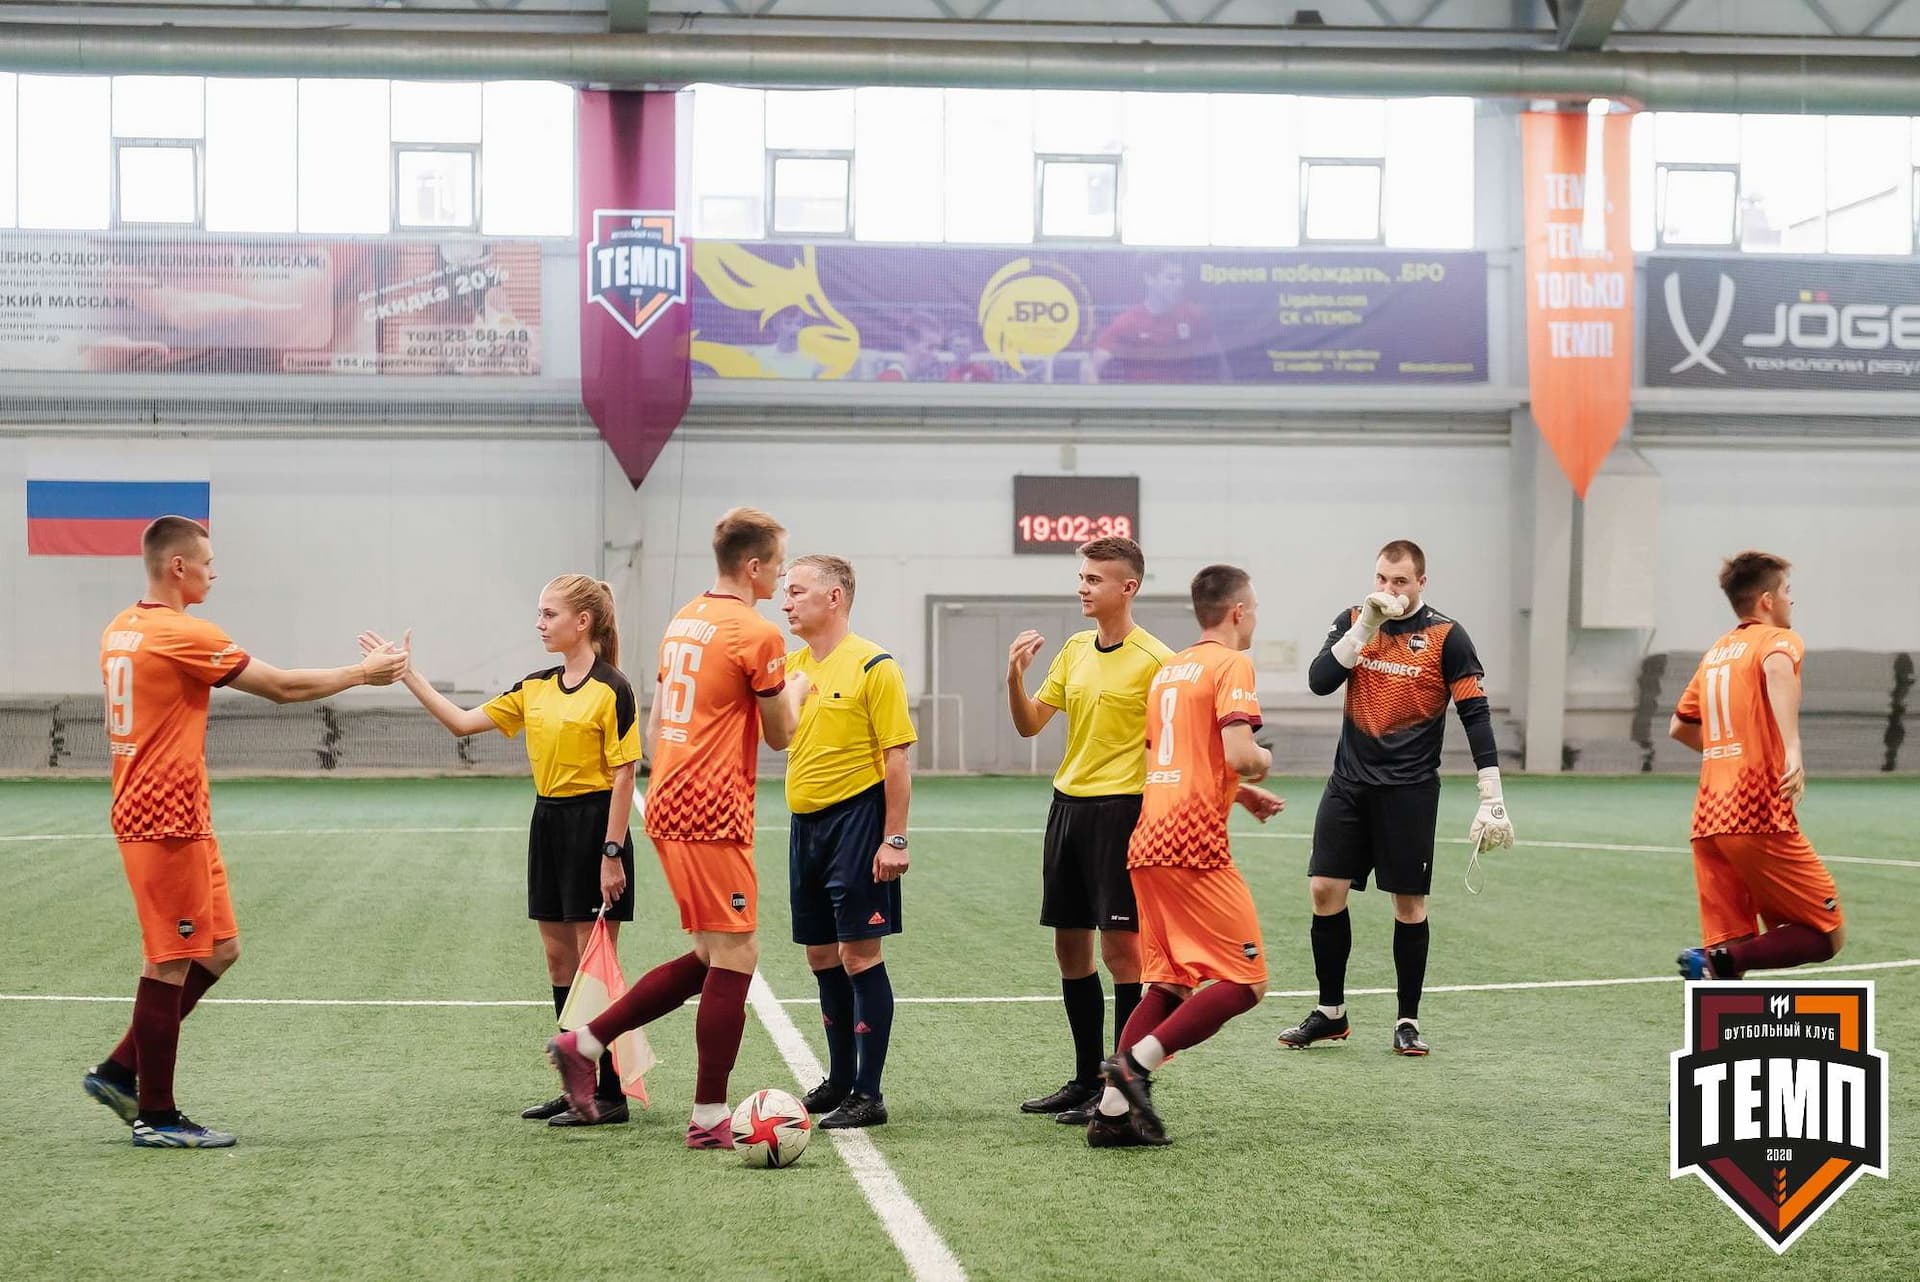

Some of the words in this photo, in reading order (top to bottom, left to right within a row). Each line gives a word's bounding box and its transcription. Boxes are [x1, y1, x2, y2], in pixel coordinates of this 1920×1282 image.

[1545, 173, 1613, 213] ТЕМ,
[1547, 222, 1614, 263] ТЕМ,
[455, 264, 509, 296] 20%
[597, 246, 676, 290] ТЕМП
[1200, 264, 1267, 284] Время
[1272, 264, 1391, 284] побеждать,
[48, 296, 134, 309] МАССАЖ:
[1536, 271, 1625, 309] ТОЛЬКО
[1007, 300, 1070, 323] .БРО
[1549, 321, 1613, 358] ТЕМП!
[1018, 515, 1131, 541] 19:02:38
[106, 656, 133, 736] 19
[1705, 664, 1734, 741] 11
[1158, 687, 1178, 766] 8
